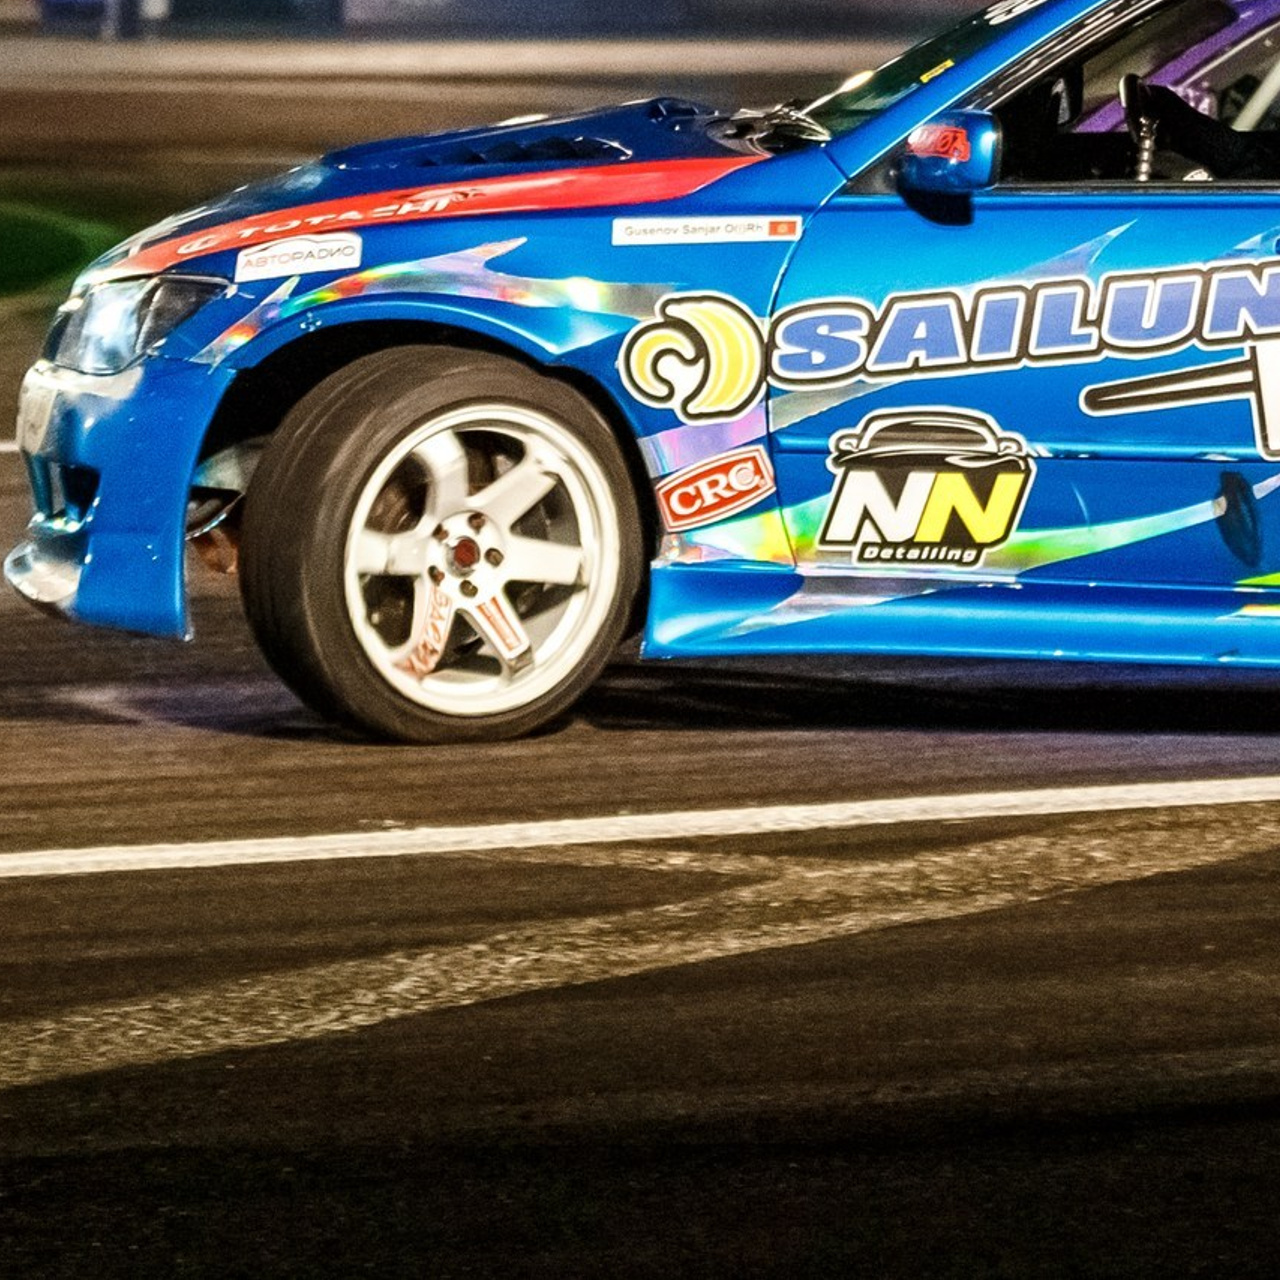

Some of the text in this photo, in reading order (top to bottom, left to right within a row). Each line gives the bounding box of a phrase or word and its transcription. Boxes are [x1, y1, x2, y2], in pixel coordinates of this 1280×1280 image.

[682, 223, 721, 237] Sanjar
[669, 460, 762, 516] CRC
[824, 470, 1026, 544] NN
